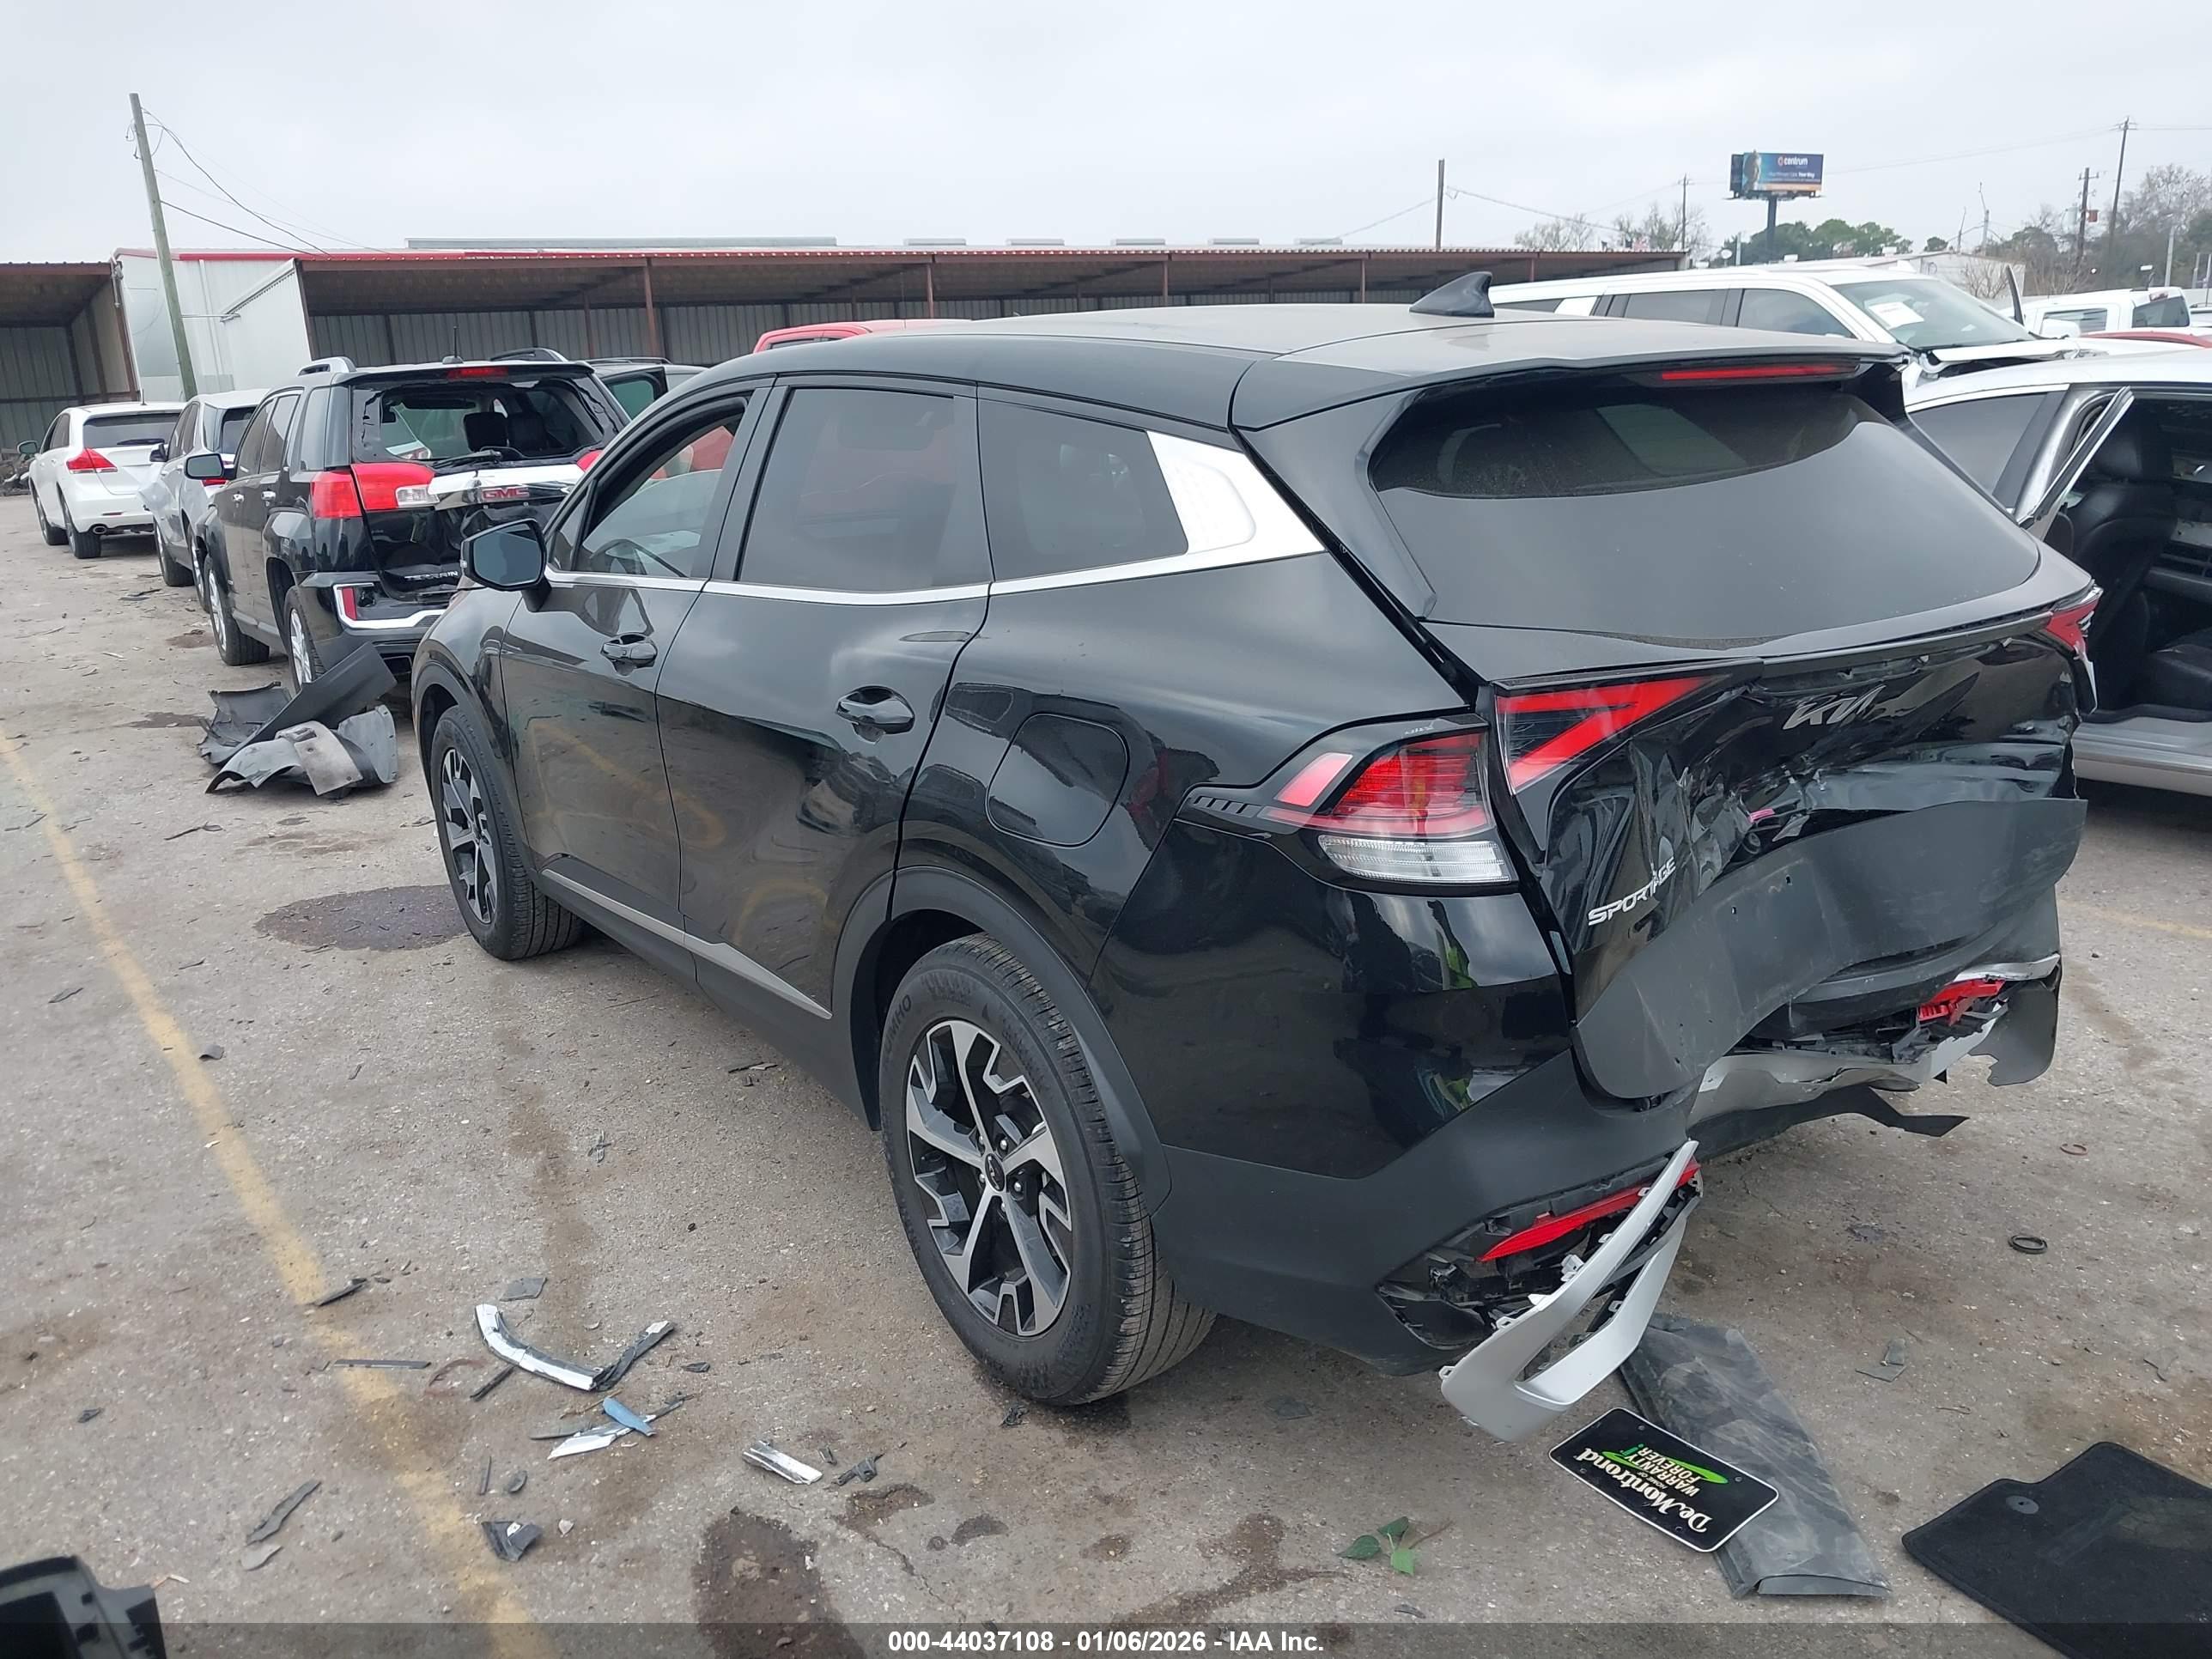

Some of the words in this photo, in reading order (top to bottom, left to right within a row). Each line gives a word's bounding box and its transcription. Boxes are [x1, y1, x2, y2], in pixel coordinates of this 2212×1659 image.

[1784, 157, 1808, 166] centrum
[482, 486, 530, 502] GMC
[1575, 1448, 1713, 1533] DeMontrond
[1623, 1452, 1700, 1498] WARRANTY
